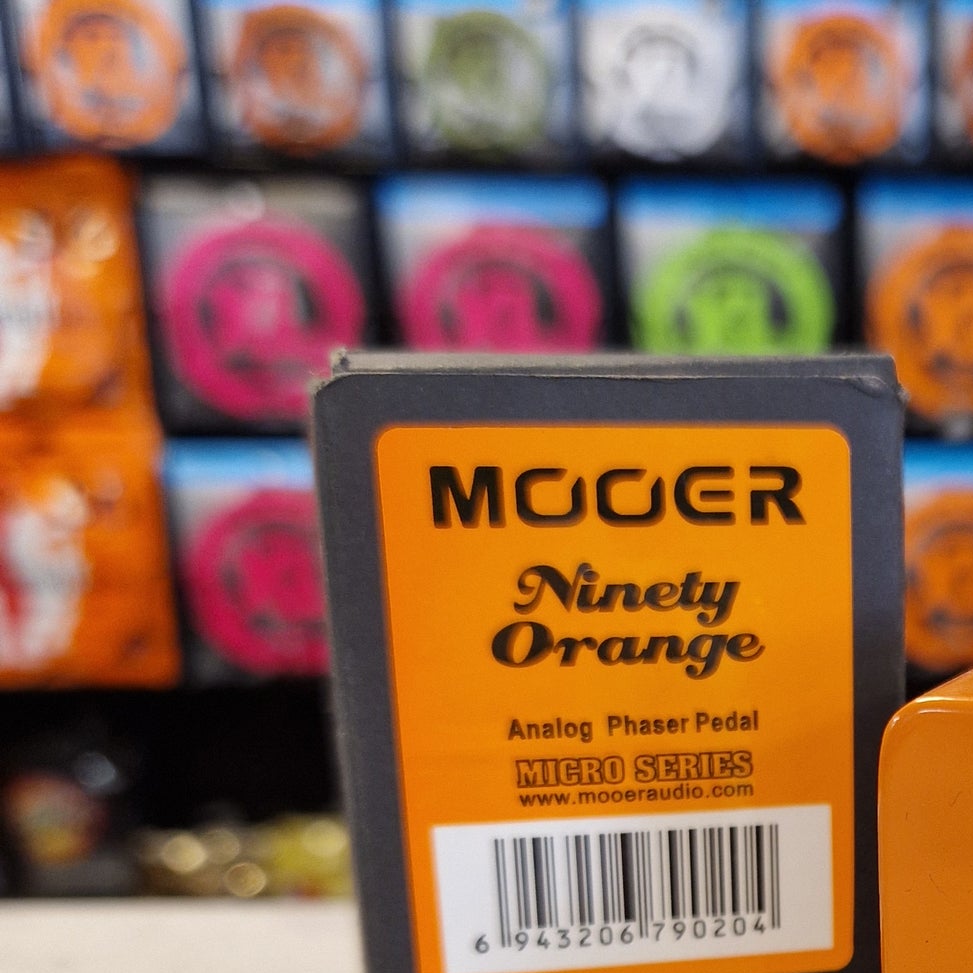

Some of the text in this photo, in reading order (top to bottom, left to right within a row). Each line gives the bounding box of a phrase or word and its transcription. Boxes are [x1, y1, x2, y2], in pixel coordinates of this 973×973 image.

[429, 465, 806, 529] MOOER
[513, 562, 740, 626] Ninety
[491, 620, 765, 680] Orange
[508, 710, 760, 742] Analog Phaser Pedal
[515, 750, 754, 789] MICRO SERIES
[519, 781, 755, 807] www.mooeraudio.com
